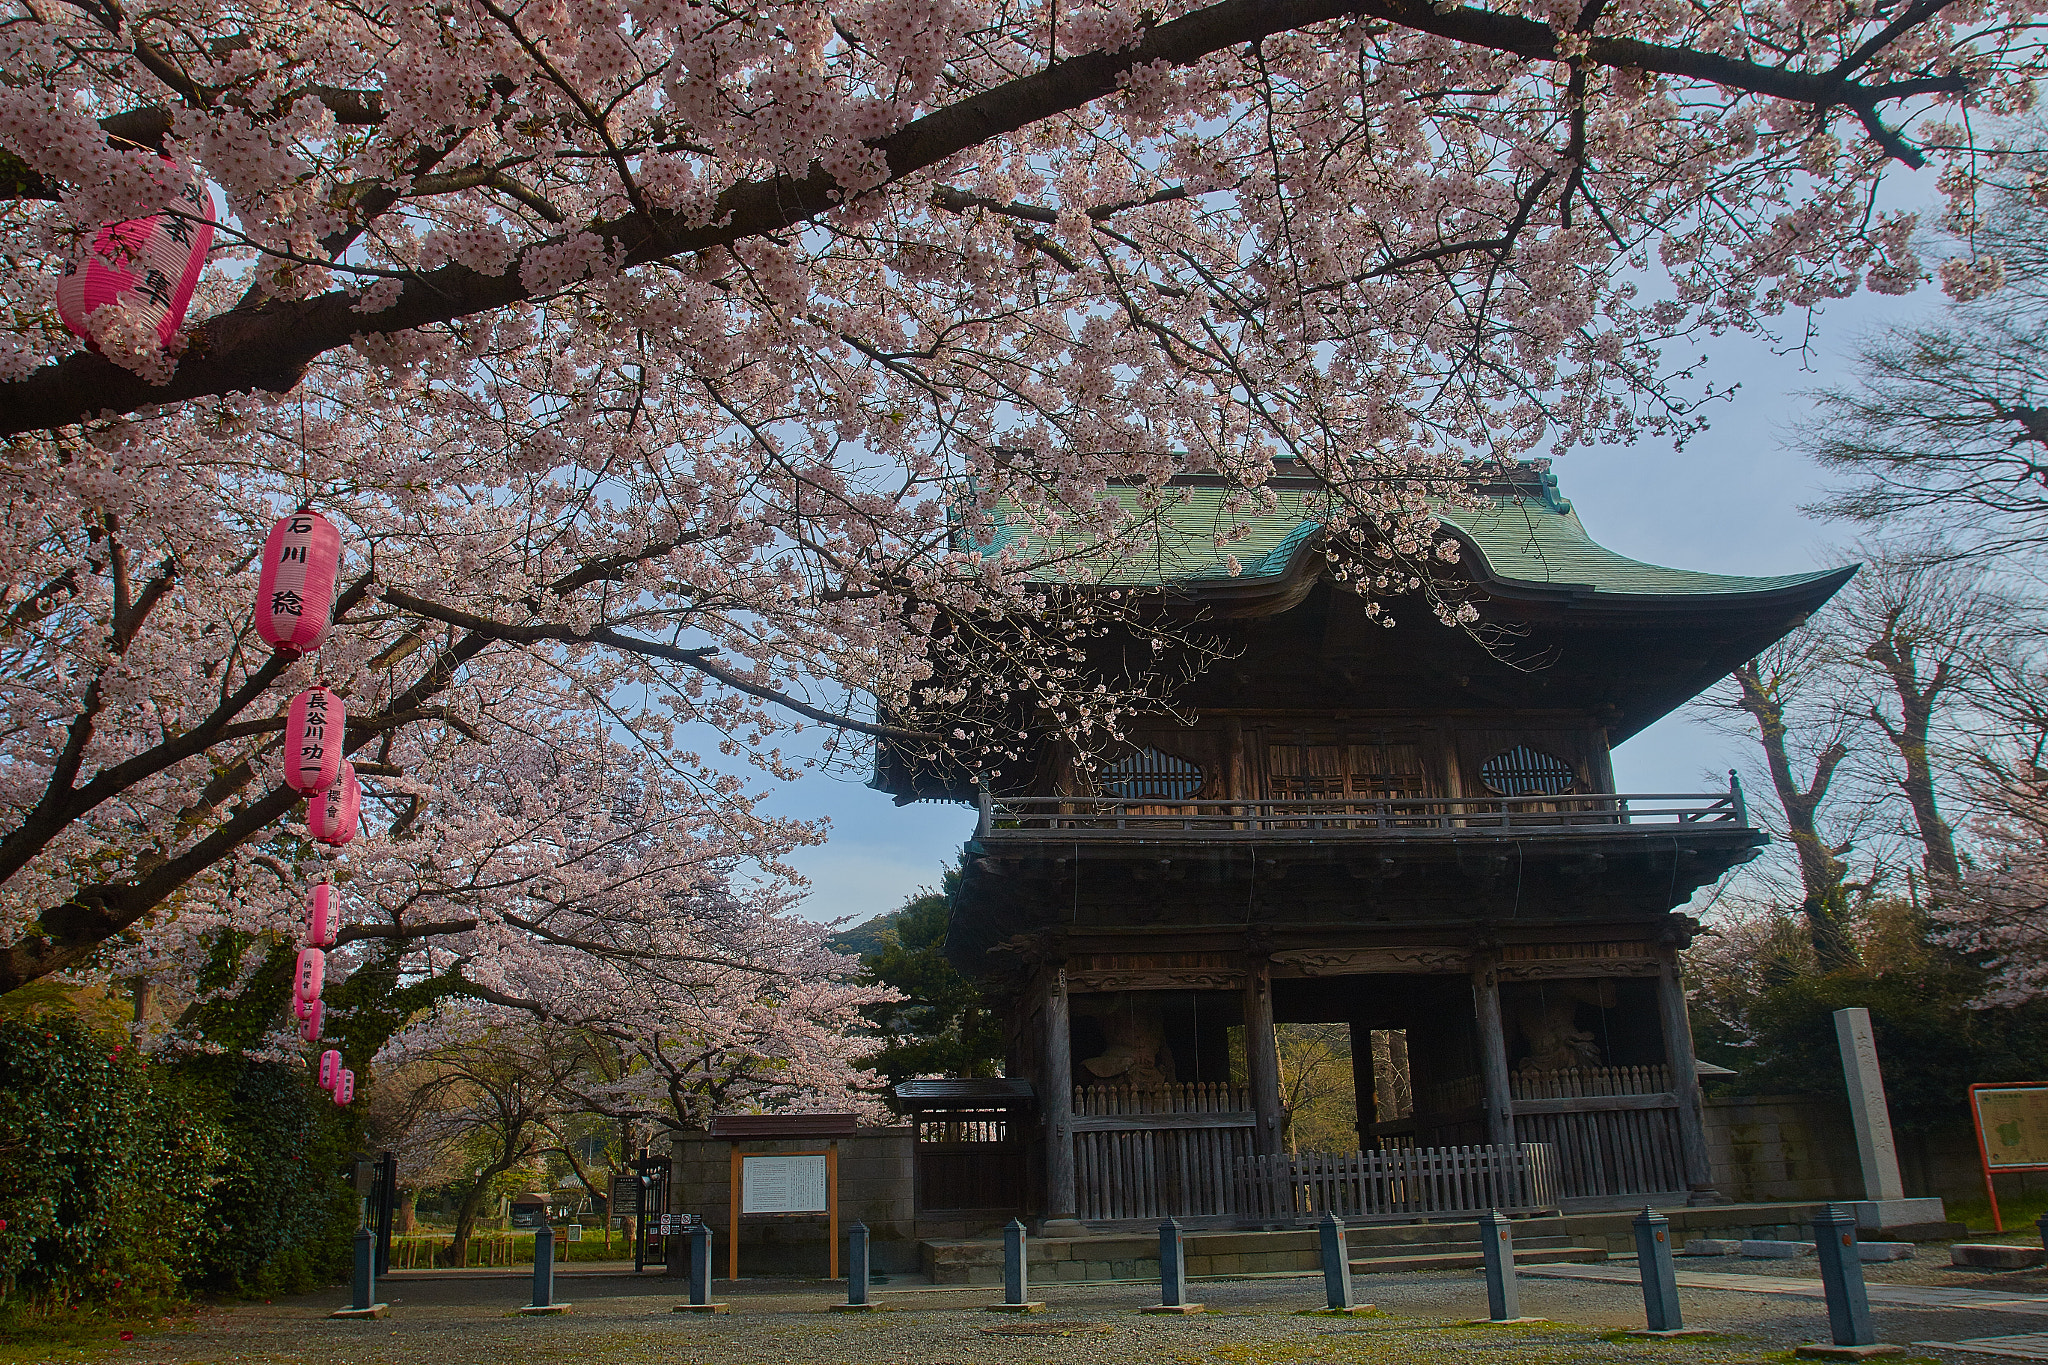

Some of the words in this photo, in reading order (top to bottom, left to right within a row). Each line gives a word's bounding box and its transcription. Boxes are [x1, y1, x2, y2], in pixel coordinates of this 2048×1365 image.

[270, 516, 313, 616] 石川稔
[299, 693, 329, 771] 長谷川功一
